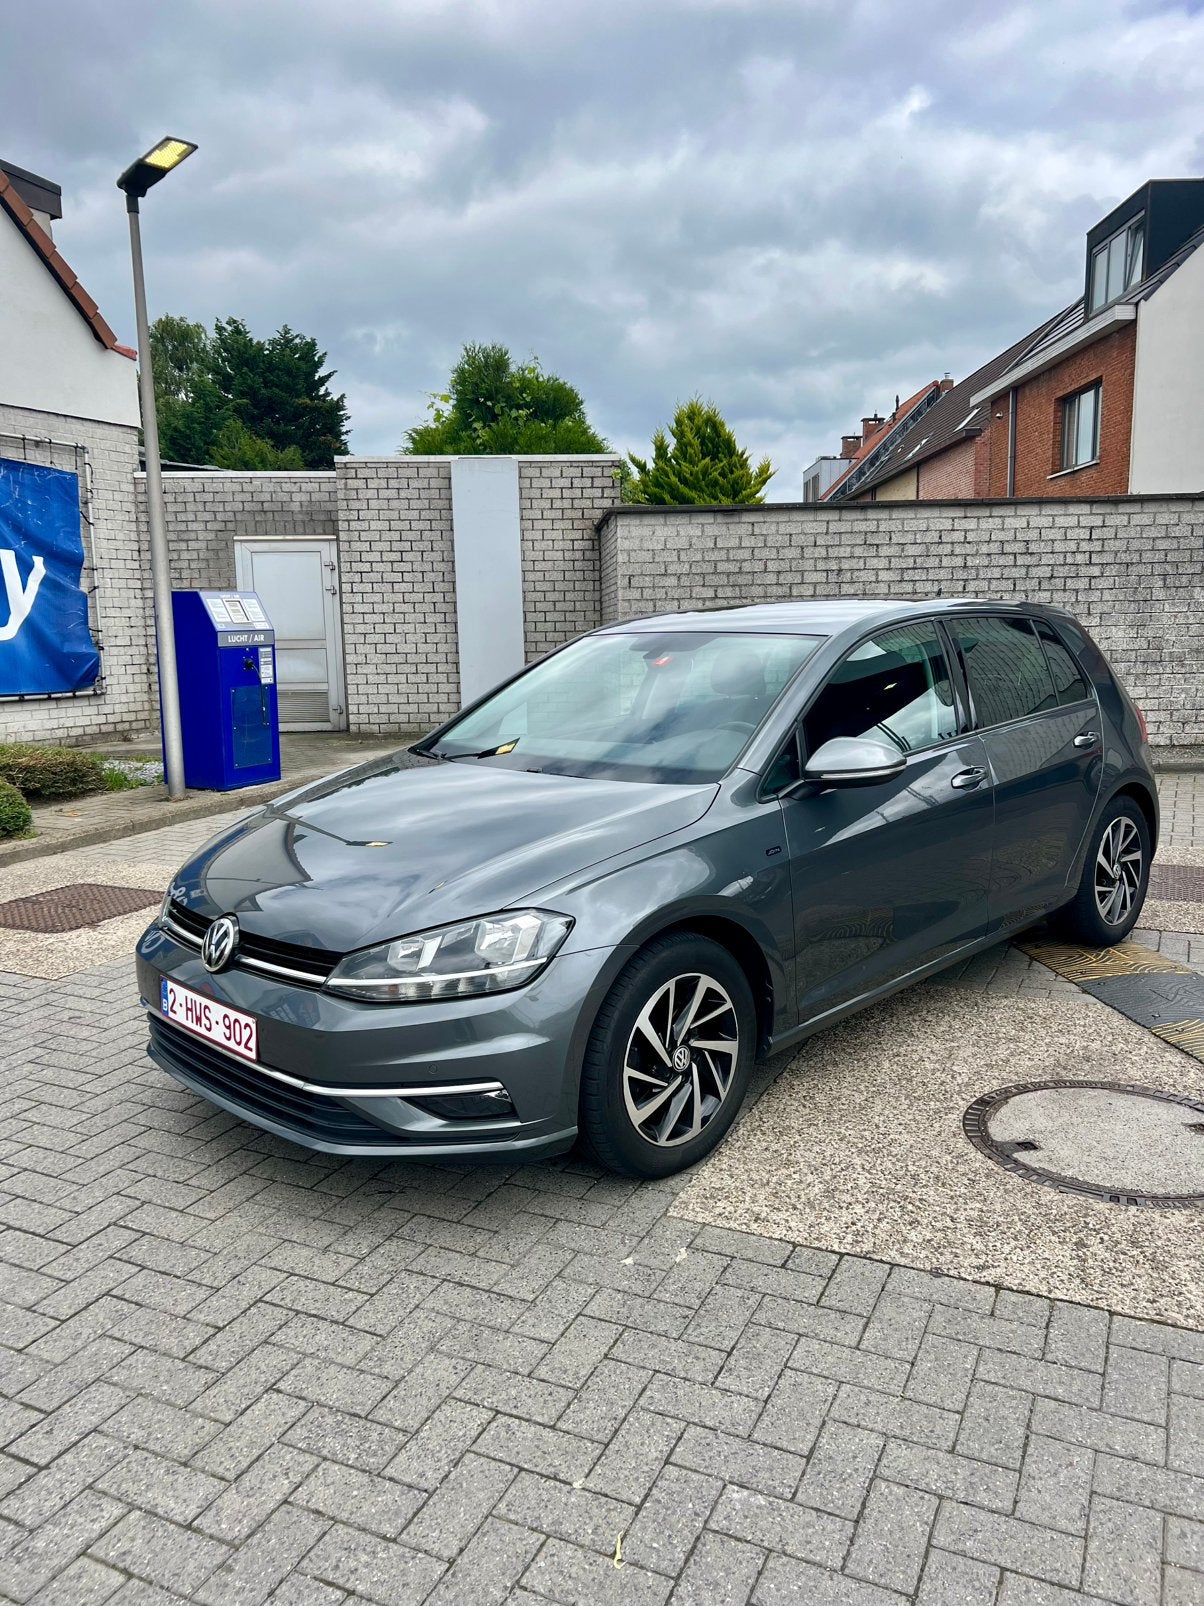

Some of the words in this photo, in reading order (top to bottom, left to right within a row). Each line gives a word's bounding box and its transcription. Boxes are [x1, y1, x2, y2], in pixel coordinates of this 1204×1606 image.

[228, 634, 248, 643] LUCHT
[253, 634, 265, 642] AIR
[169, 988, 254, 1052] 2-HWS-902
